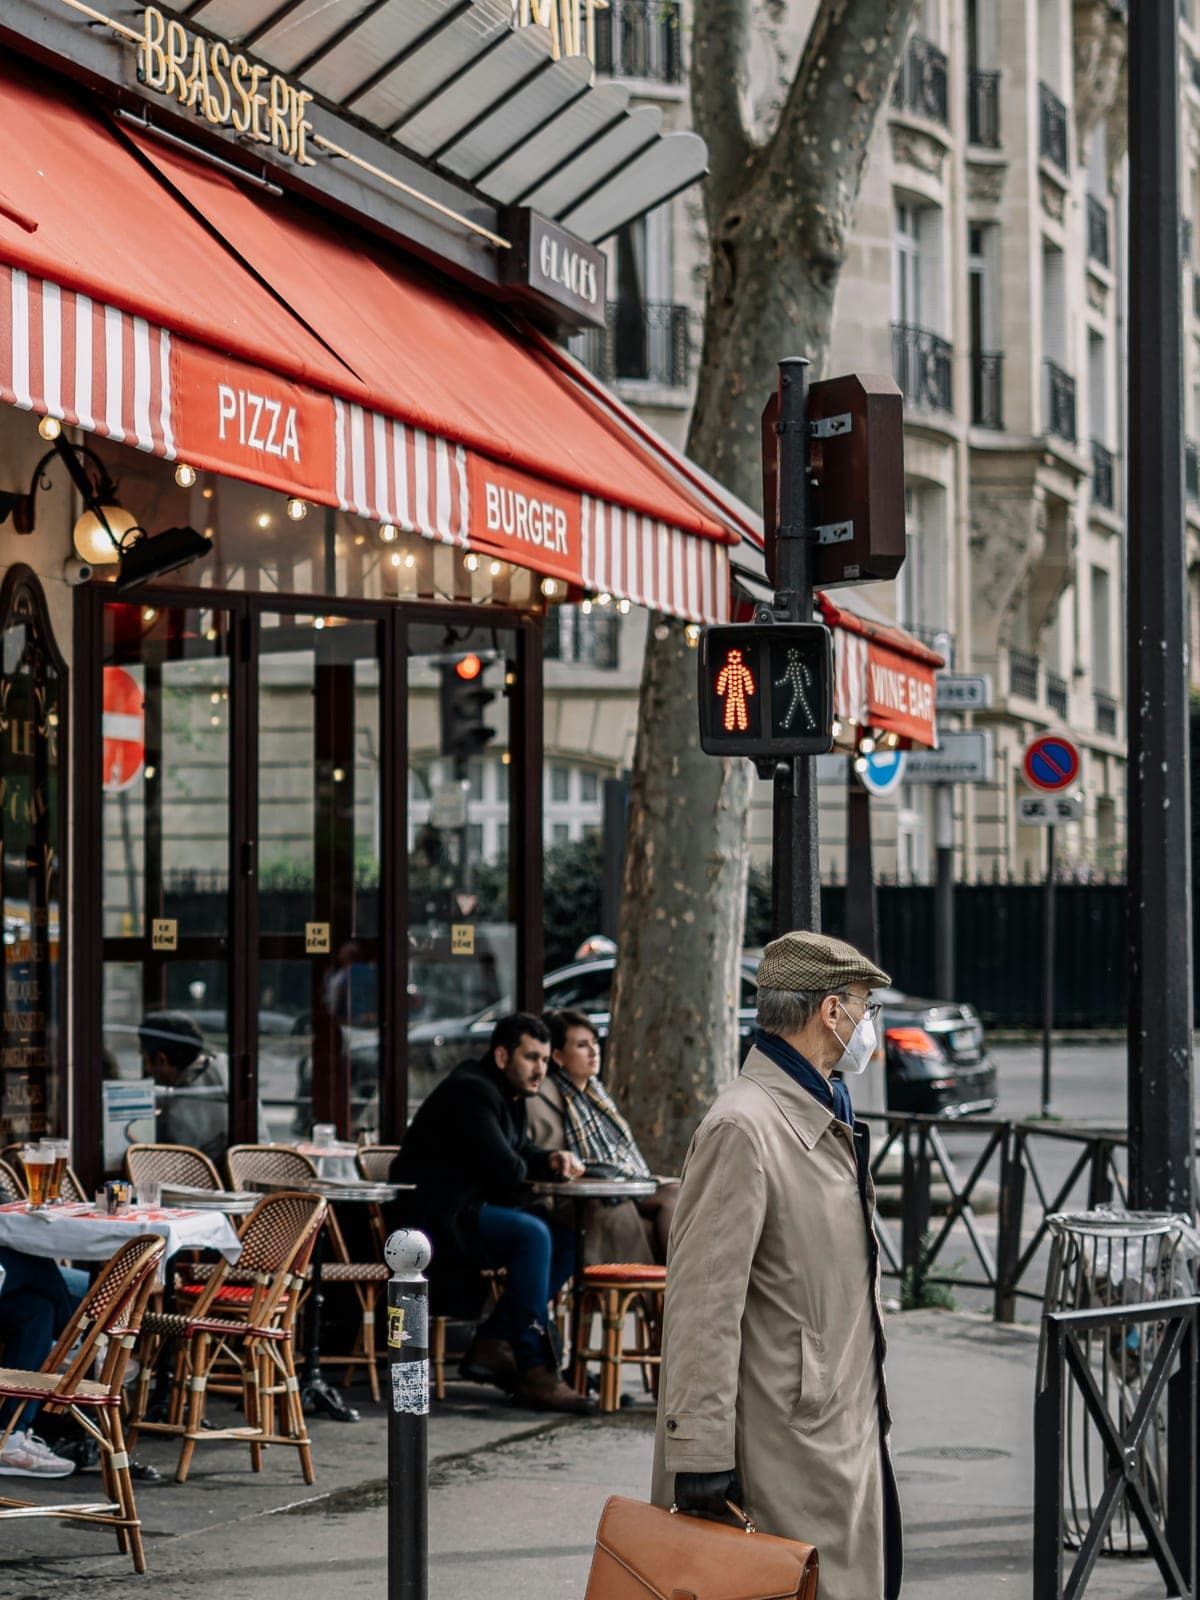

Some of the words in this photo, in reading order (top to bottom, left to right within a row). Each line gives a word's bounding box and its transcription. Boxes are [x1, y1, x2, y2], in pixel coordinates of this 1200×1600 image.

[143, 6, 316, 166] BRASSERIE
[540, 234, 598, 305] GLACES
[218, 383, 300, 463] PIZZA
[485, 482, 568, 556] BURGER
[870, 662, 908, 713] WINE
[907, 677, 933, 722] BAR
